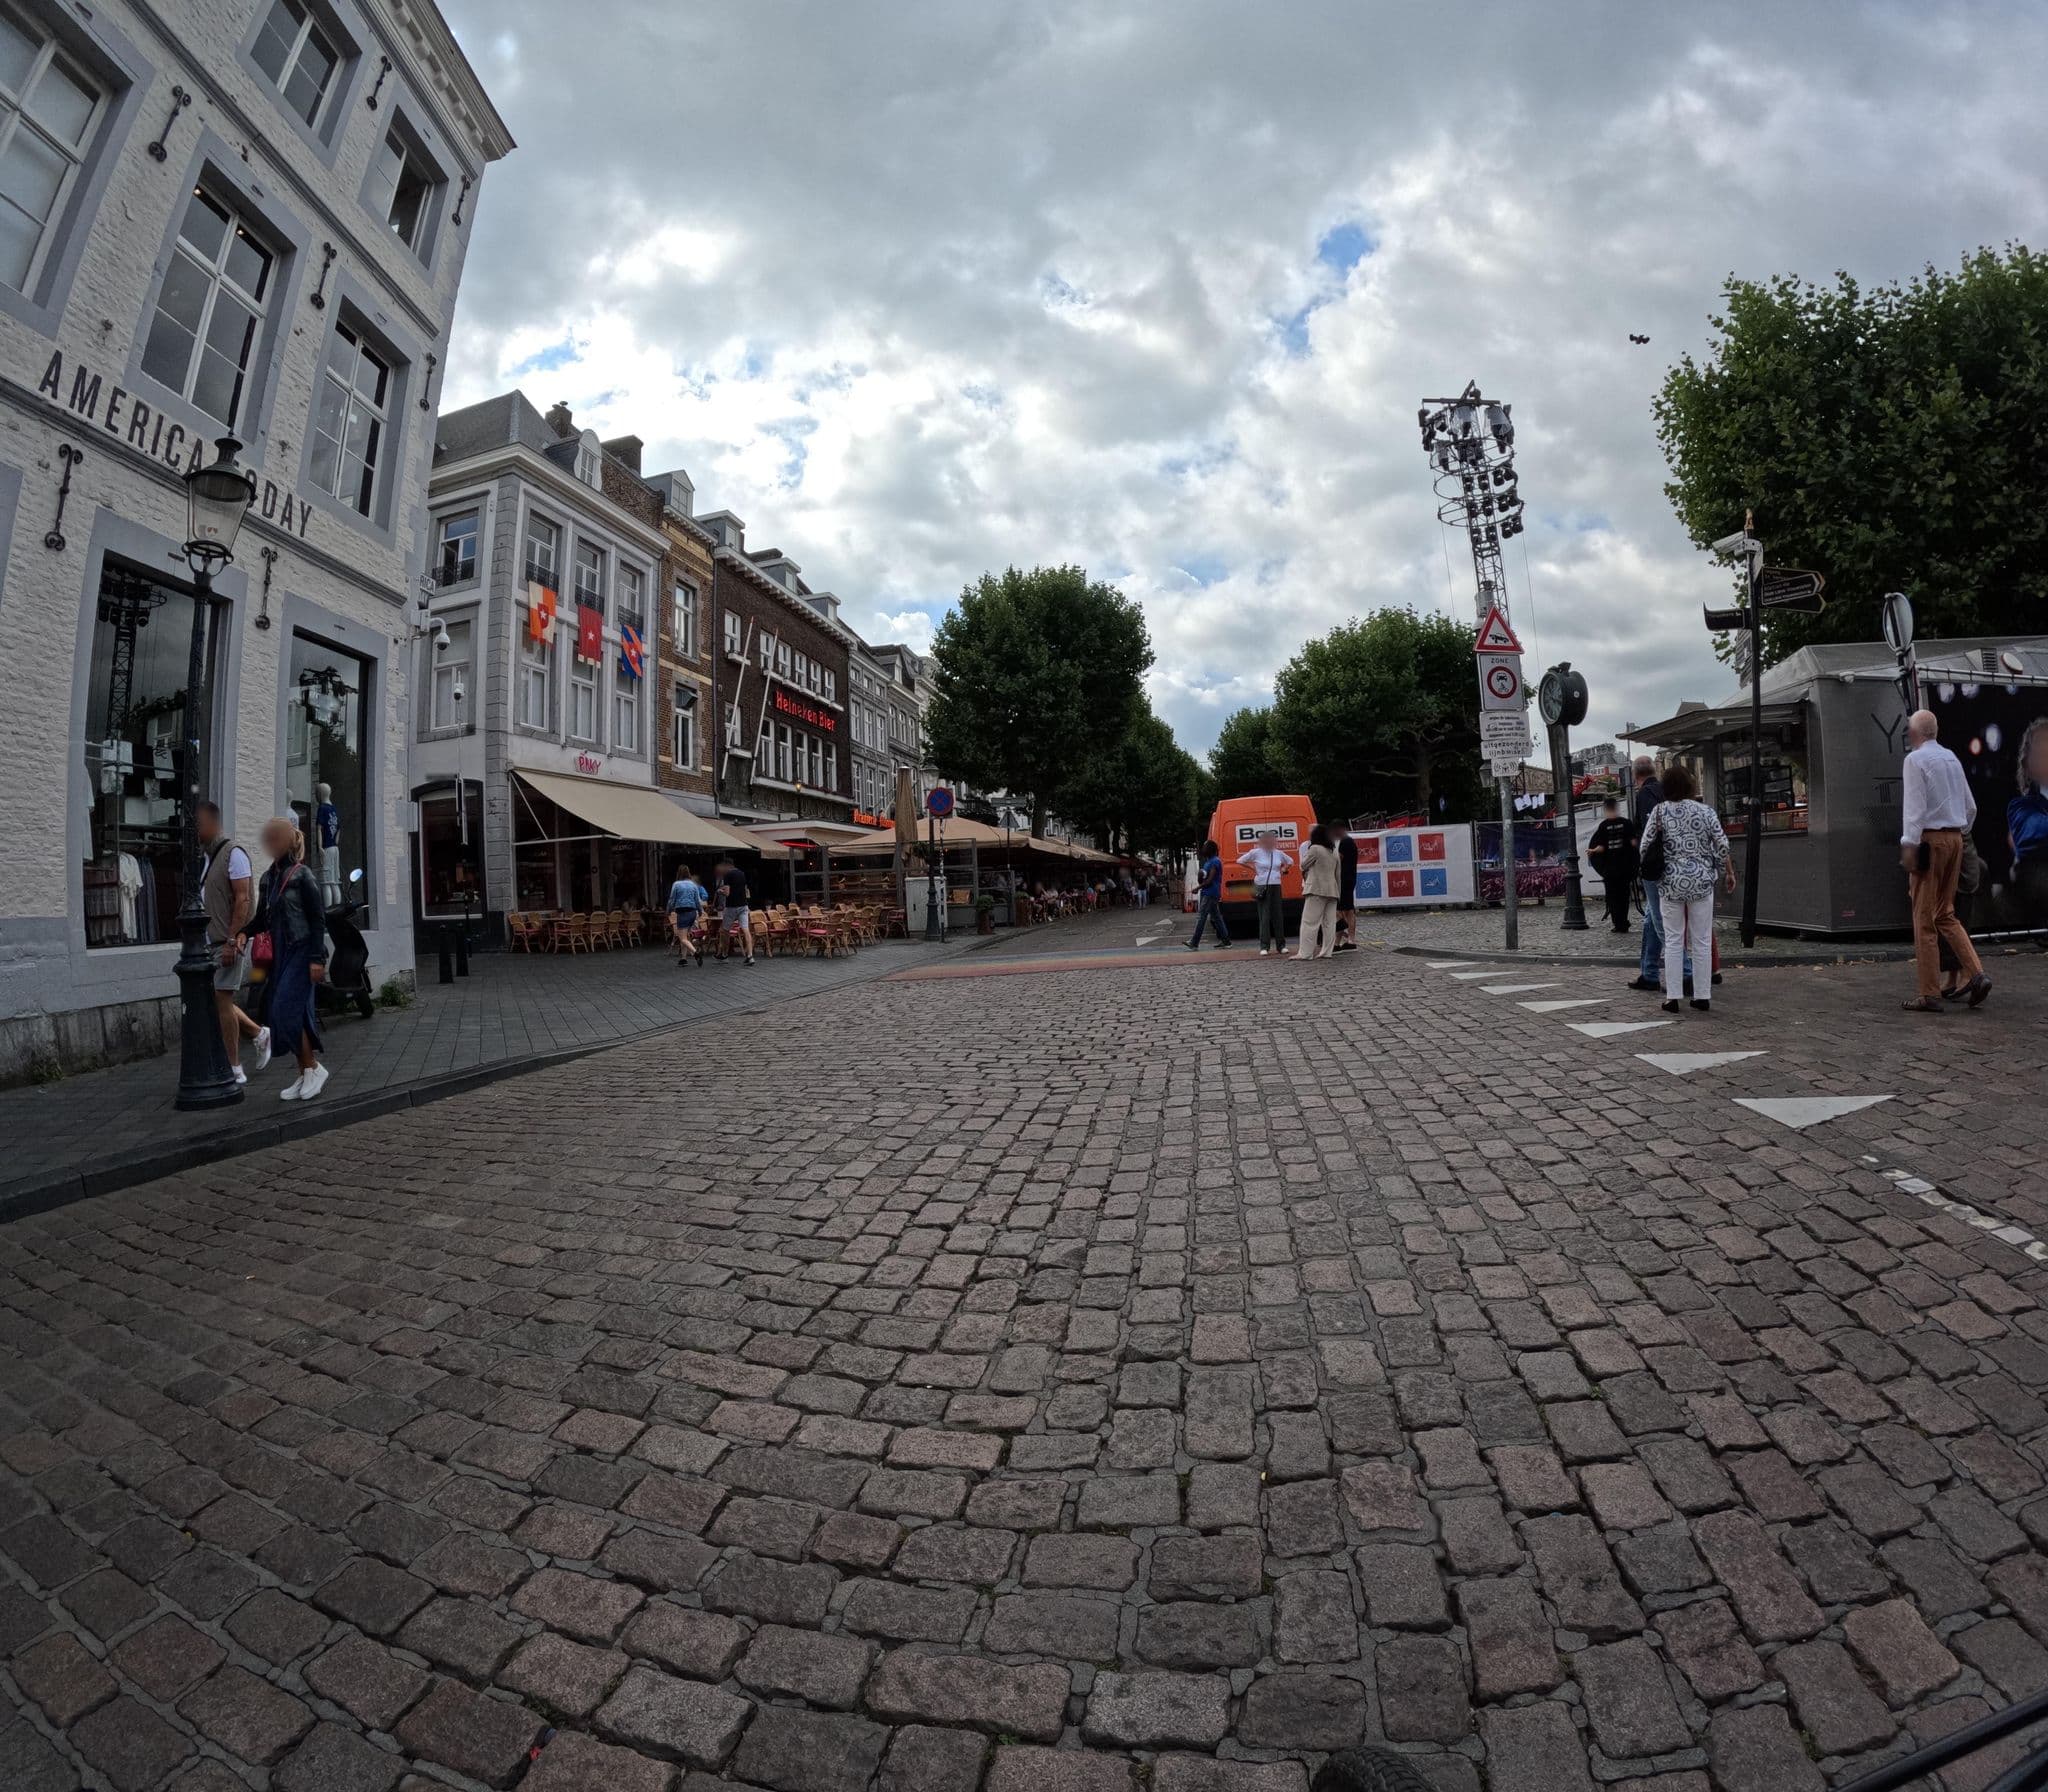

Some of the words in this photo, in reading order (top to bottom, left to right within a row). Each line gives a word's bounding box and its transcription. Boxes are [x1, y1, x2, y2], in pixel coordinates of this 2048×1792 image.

[38, 348, 203, 476] AMERICA
[233, 460, 312, 538] ODAY
[775, 689, 818, 725] Heineken
[818, 710, 836, 732] Bier
[1239, 826, 1294, 840] Boels
